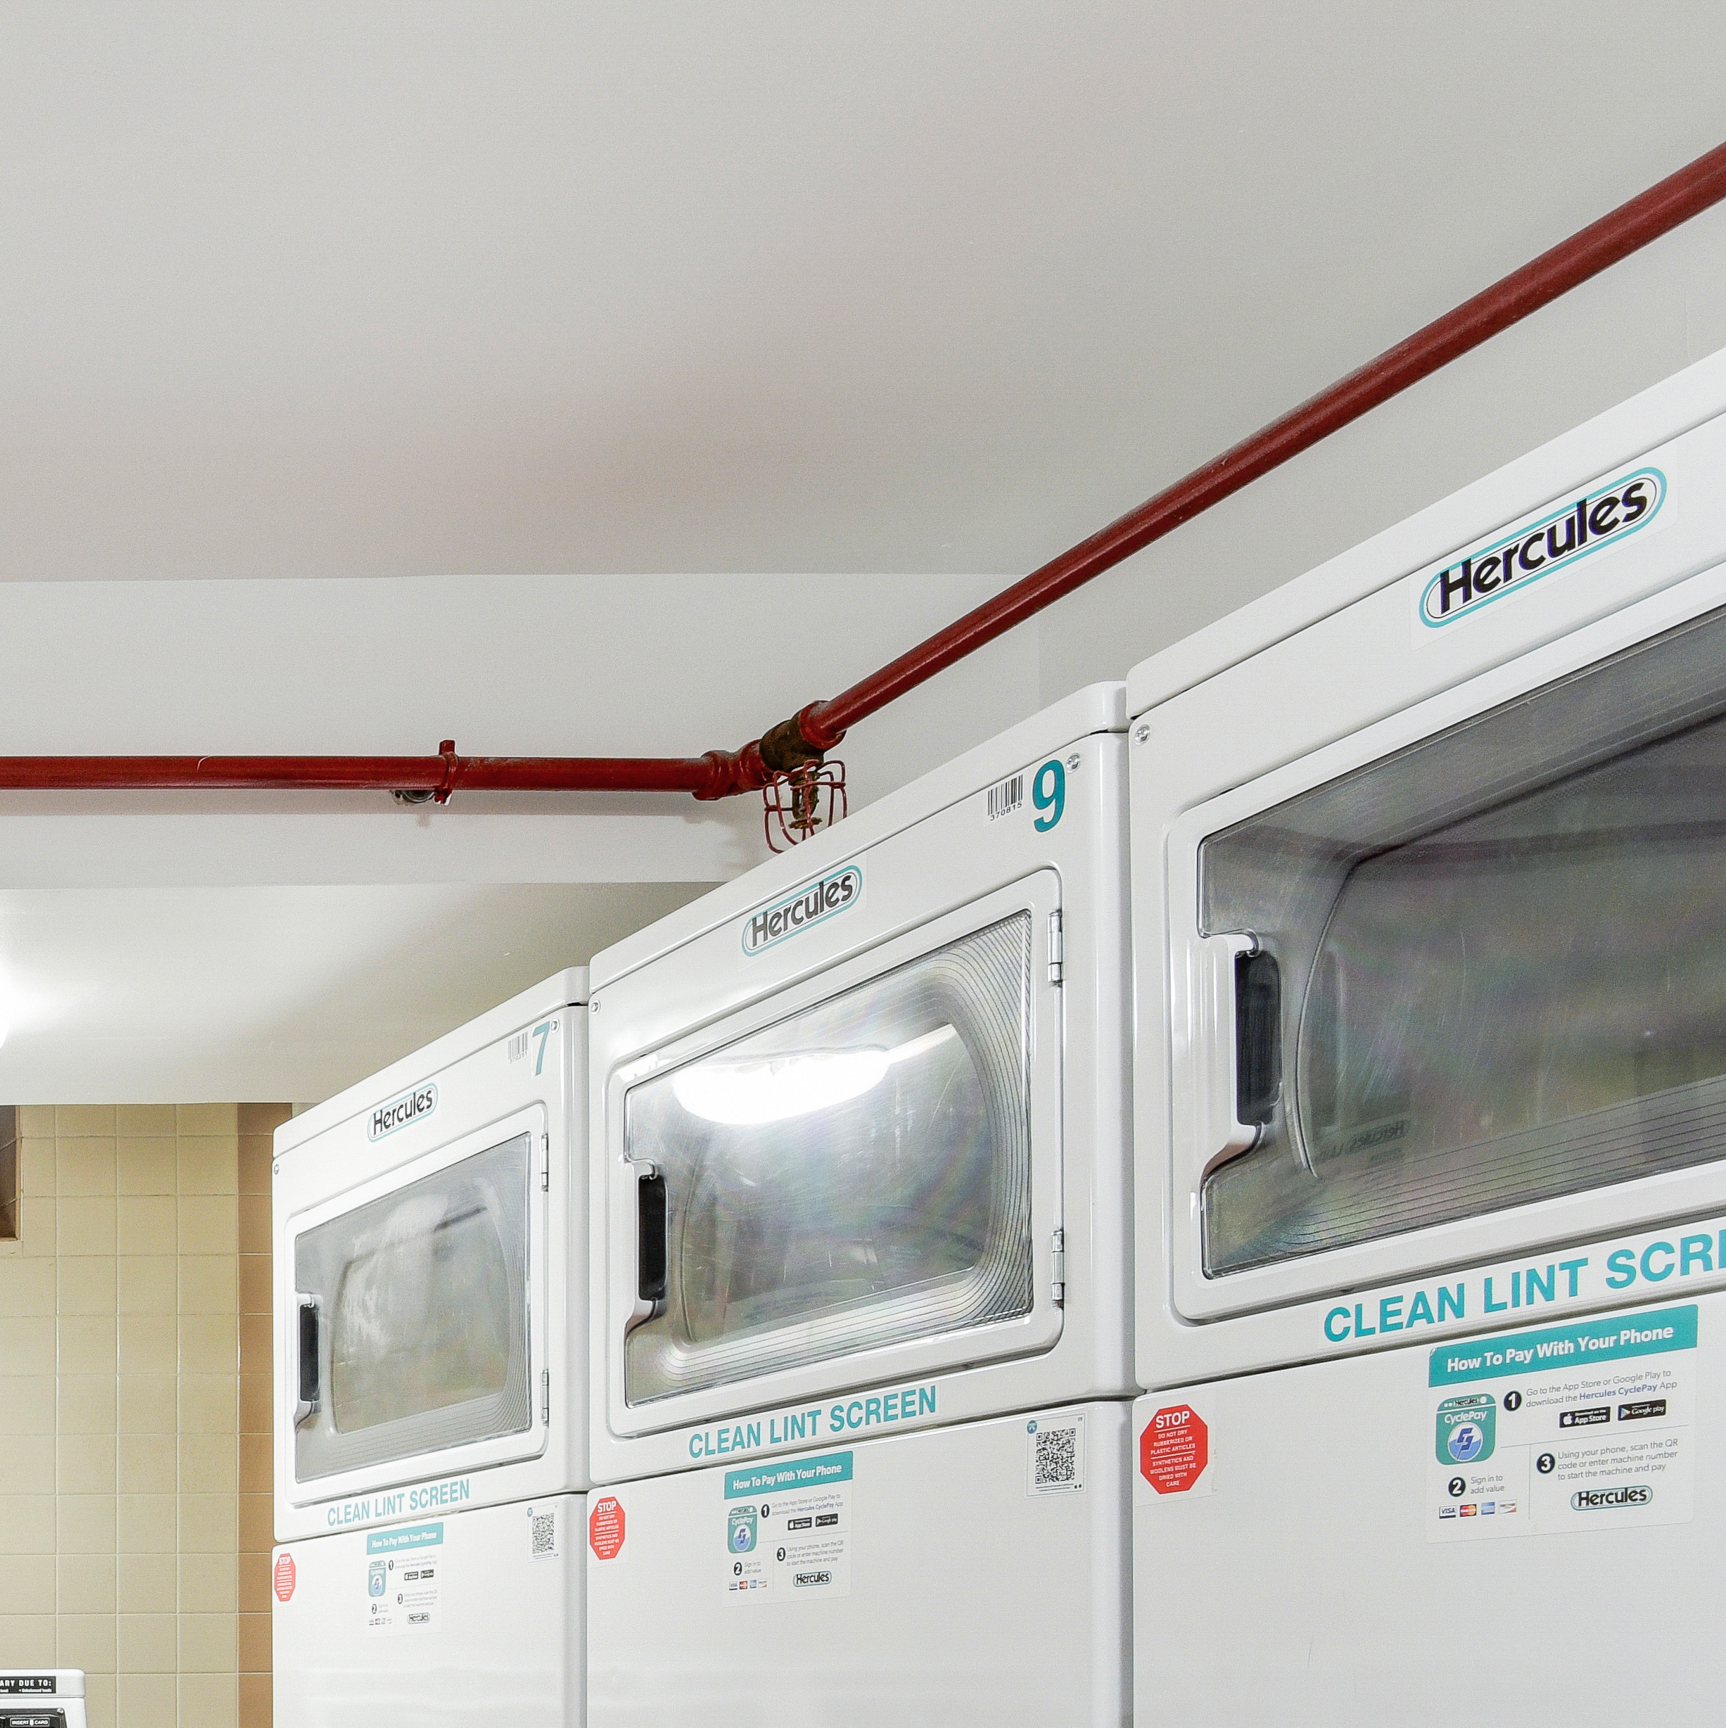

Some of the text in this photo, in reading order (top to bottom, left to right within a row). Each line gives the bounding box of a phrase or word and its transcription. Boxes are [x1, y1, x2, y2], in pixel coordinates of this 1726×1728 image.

[1439, 480, 1649, 613] Hercules
[1032, 759, 1066, 833] 9
[751, 873, 853, 949] Hercules
[531, 1020, 550, 1076] 7
[373, 1088, 433, 1135] Hercules
[1323, 1282, 1466, 1342] CLEAN
[1483, 1257, 1589, 1314] LINT
[1447, 1326, 1675, 1373] How To Pay With Your Phone
[1526, 1387, 1538, 1396] Go
[1540, 1386, 1548, 1394] to
[1549, 1383, 1561, 1393] the
[1562, 1381, 1579, 1392] App
[1580, 1379, 1601, 1390] Store
[1612, 1373, 1643, 1386] Google
[1644, 1371, 1661, 1381] Play
[1662, 1370, 1671, 1378] to
[1526, 1381, 1677, 1408] download the Hercules CyclePay App
[689, 1385, 937, 1459] CLEAN LINT SCREEN
[1156, 1410, 1190, 1428] STOP
[1444, 1411, 1488, 1423] CyclePay
[328, 1479, 470, 1527] CLEAN LINT SCREEN
[1578, 1487, 1647, 1506] Hercules
[19, 1679, 35, 1687] DUE
